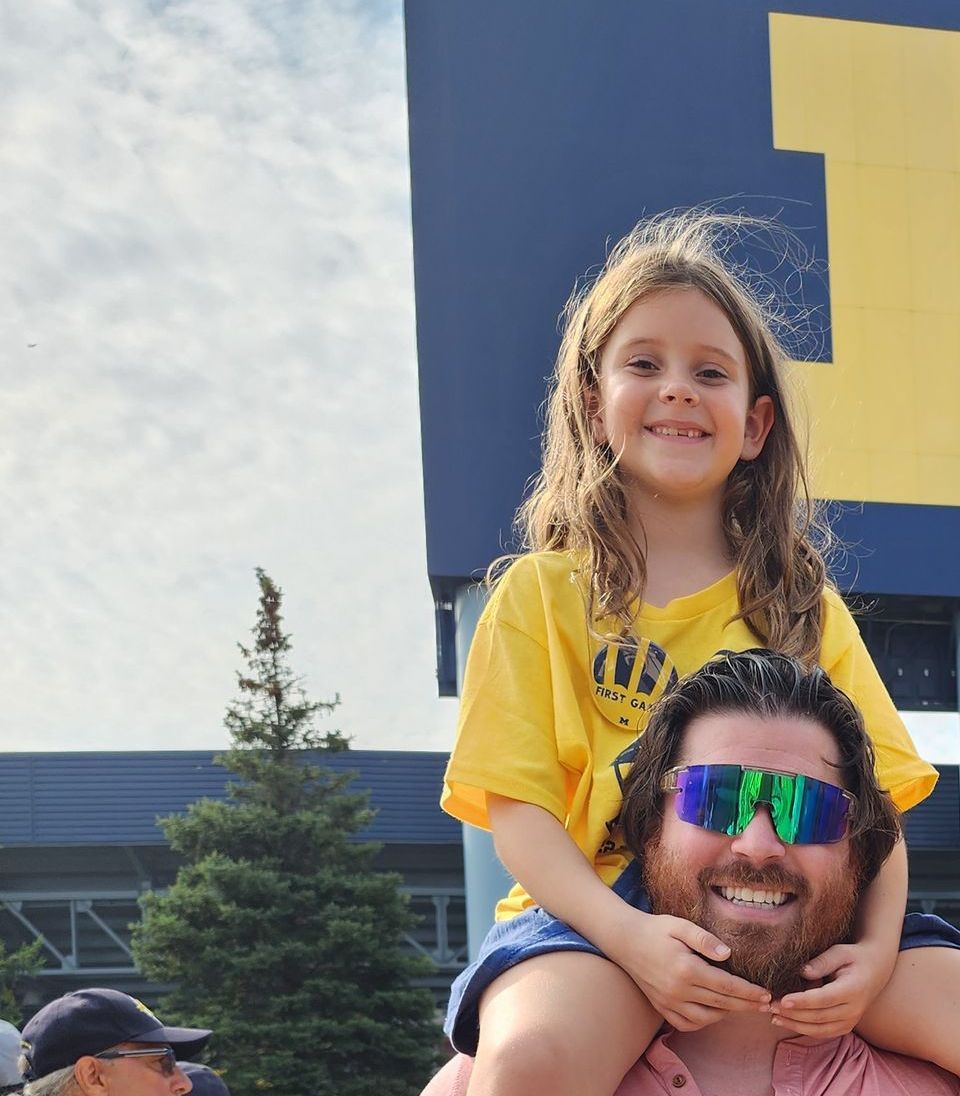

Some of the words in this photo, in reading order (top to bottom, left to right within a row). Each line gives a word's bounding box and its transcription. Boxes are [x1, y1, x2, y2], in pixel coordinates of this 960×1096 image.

[595, 686, 626, 704] FIRST
[630, 698, 654, 713] GA
[619, 717, 630, 726] M
